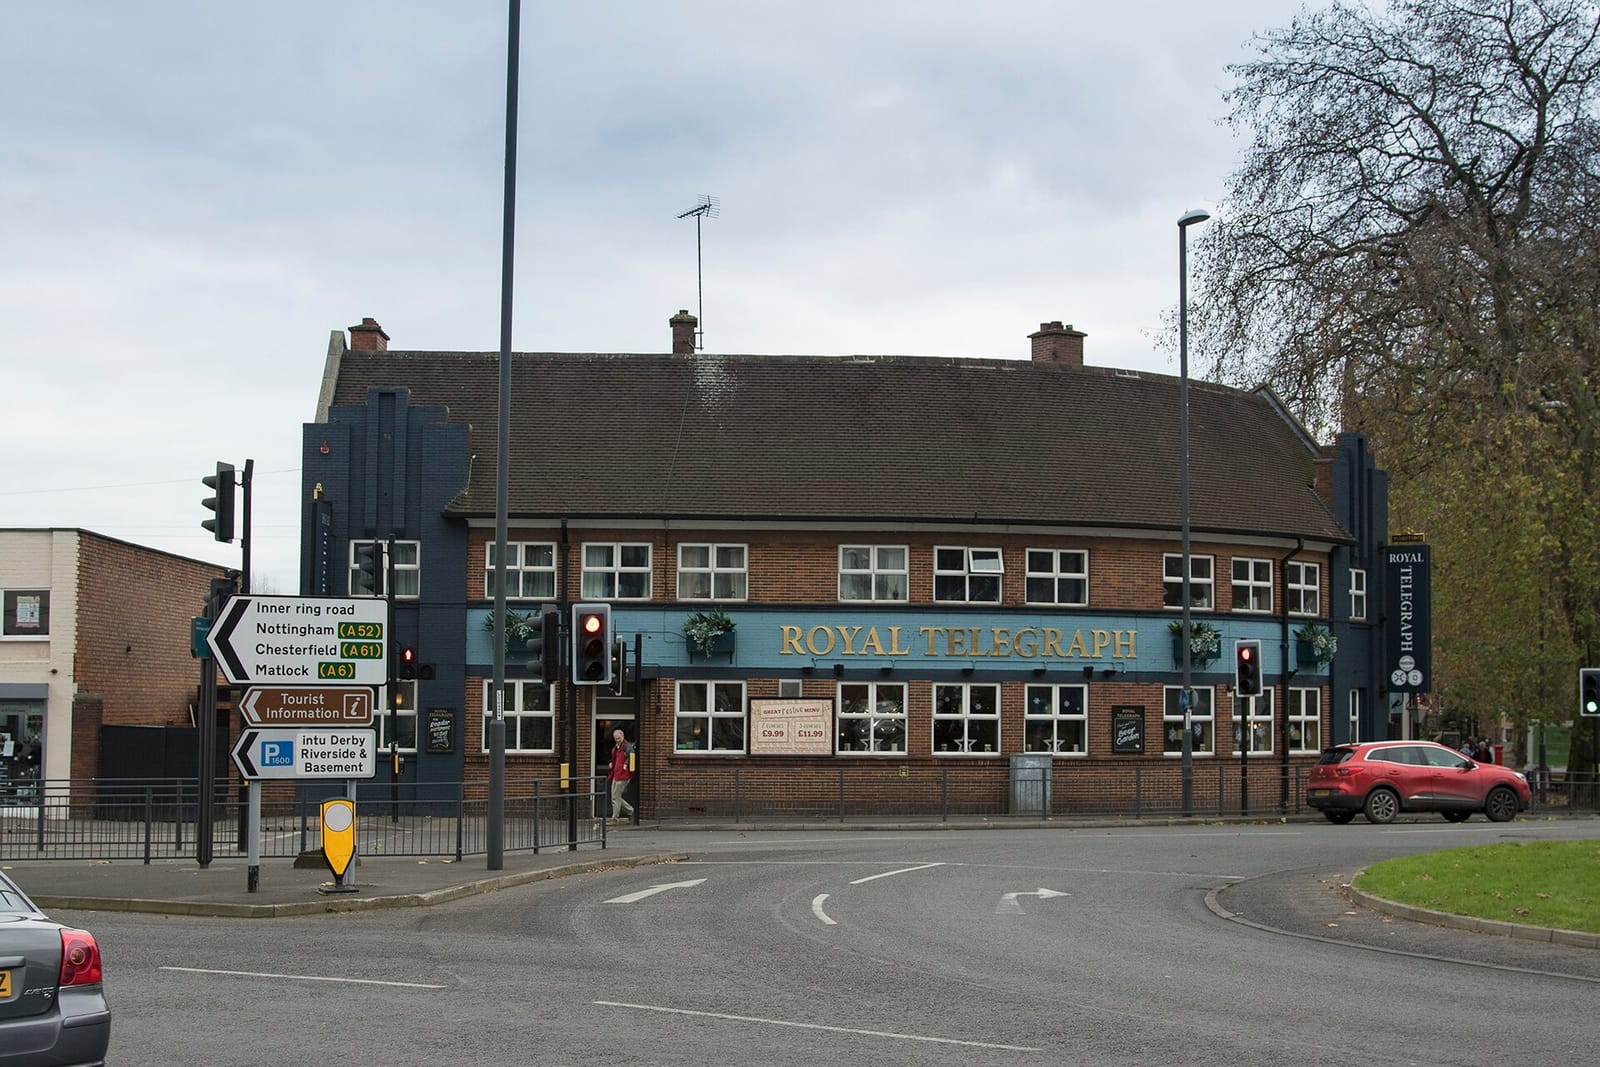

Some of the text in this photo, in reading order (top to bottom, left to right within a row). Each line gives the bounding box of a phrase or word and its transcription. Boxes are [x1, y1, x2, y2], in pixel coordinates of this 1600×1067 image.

[1389, 553, 1424, 563] ROYAL
[256, 602, 355, 616] Inner ring road
[1400, 565, 1413, 652] TELEGRAPH
[256, 623, 335, 638] Nottingham
[779, 625, 1138, 659] ROYAL TELEGRAPH
[255, 644, 337, 656] Chesterfield
[256, 664, 309, 676] Matlock
[281, 693, 325, 705] Tourist
[266, 708, 340, 719] Information
[302, 735, 366, 747] intu Derby
[264, 744, 281, 764] P
[301, 749, 368, 759] Riverside &
[304, 762, 364, 773] Basement
